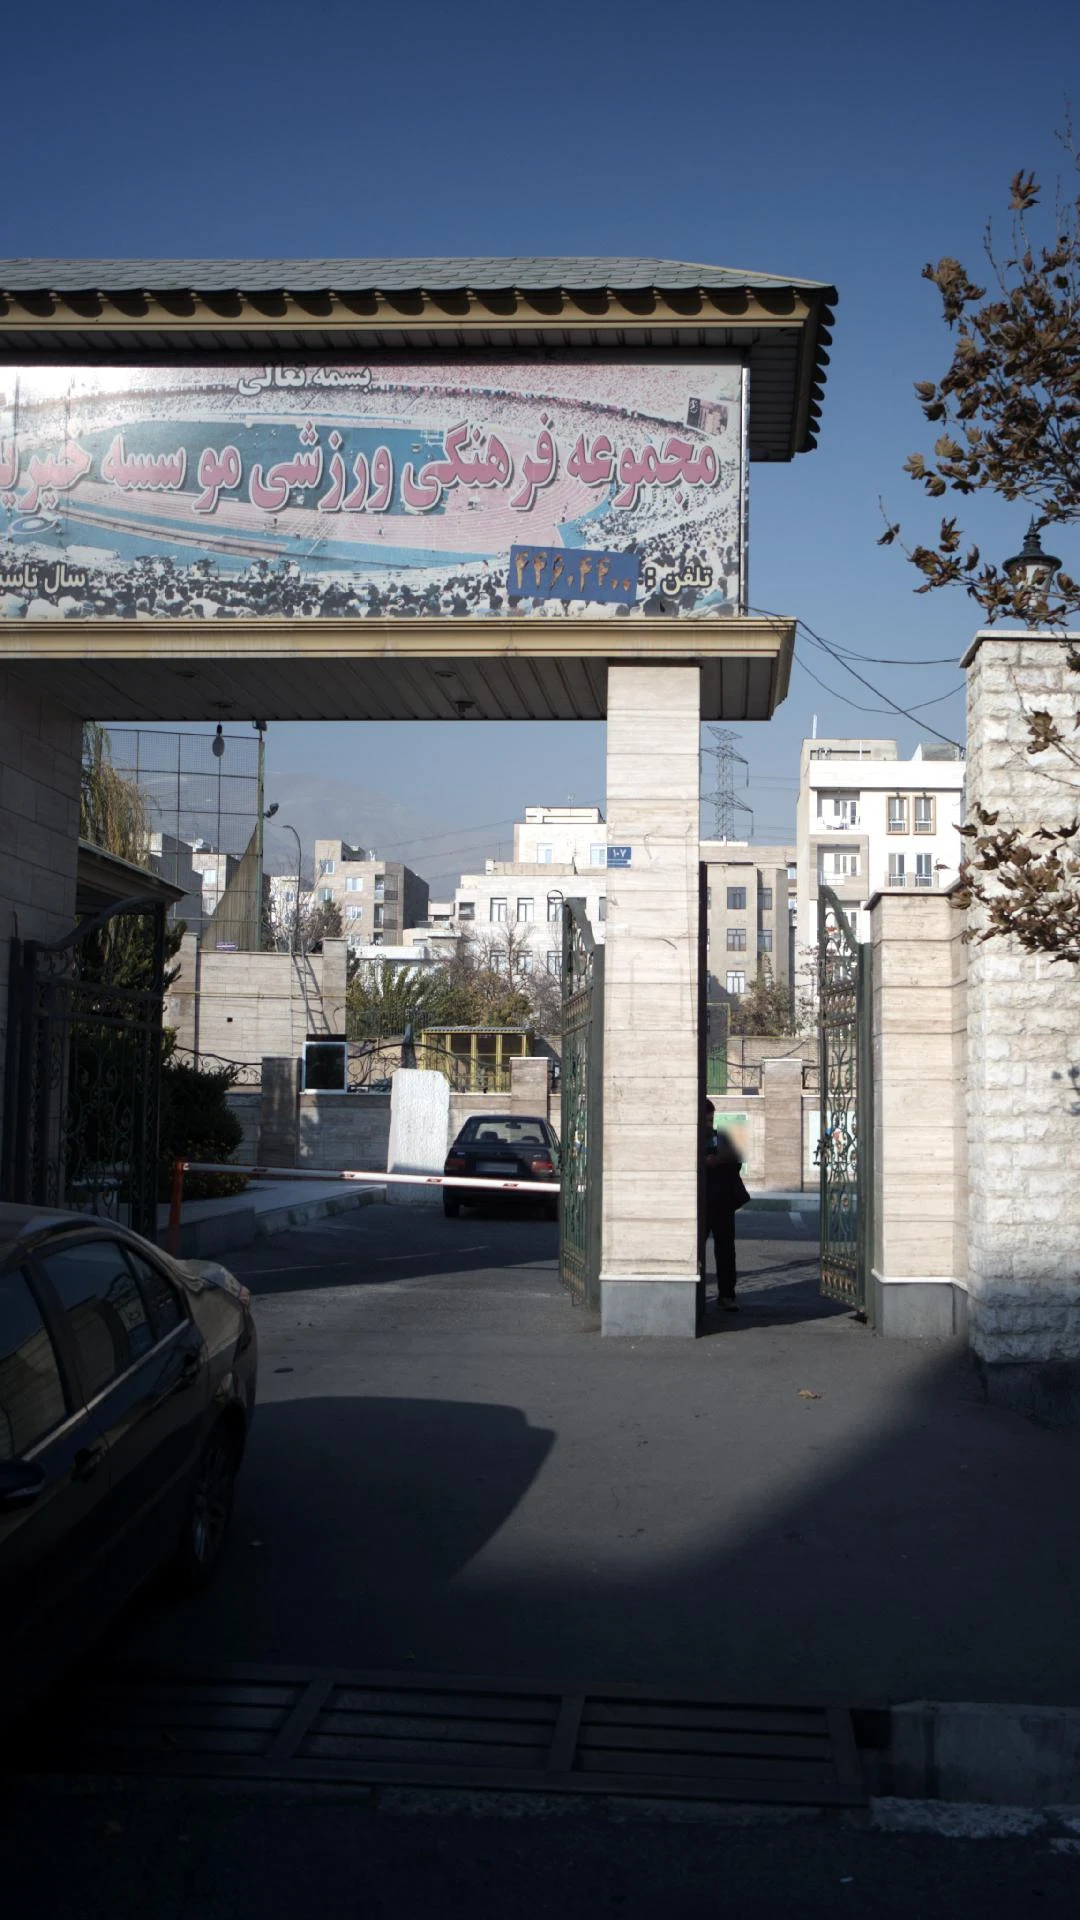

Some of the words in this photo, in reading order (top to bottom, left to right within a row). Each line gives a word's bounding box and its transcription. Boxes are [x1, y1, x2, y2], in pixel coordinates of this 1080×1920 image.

[311, 366, 372, 395] بسمه
[249, 420, 394, 513] ورزشی
[402, 412, 561, 512] فرهنگی
[566, 432, 721, 512] مجموعه
[44, 563, 86, 594] سال
[660, 564, 713, 597] تلفن
[612, 848, 627, 858] ۱۰۷
